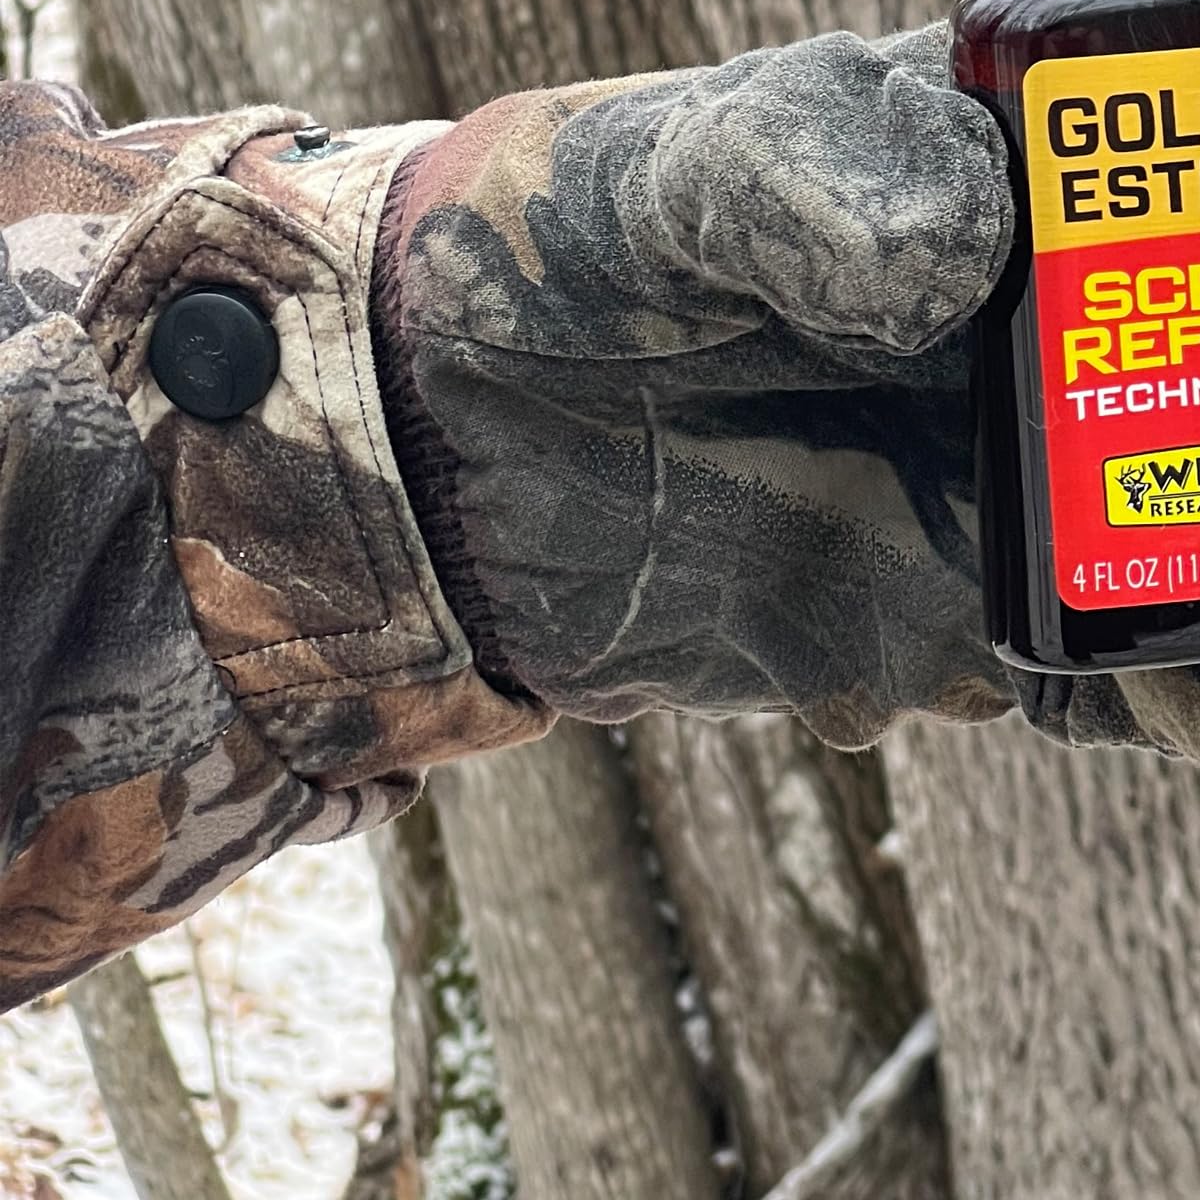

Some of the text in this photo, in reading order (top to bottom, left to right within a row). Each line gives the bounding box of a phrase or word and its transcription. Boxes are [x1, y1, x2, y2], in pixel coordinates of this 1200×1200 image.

[1073, 563, 1087, 593] 4
[1094, 561, 1121, 592] FL
[1126, 557, 1160, 589] OZ
